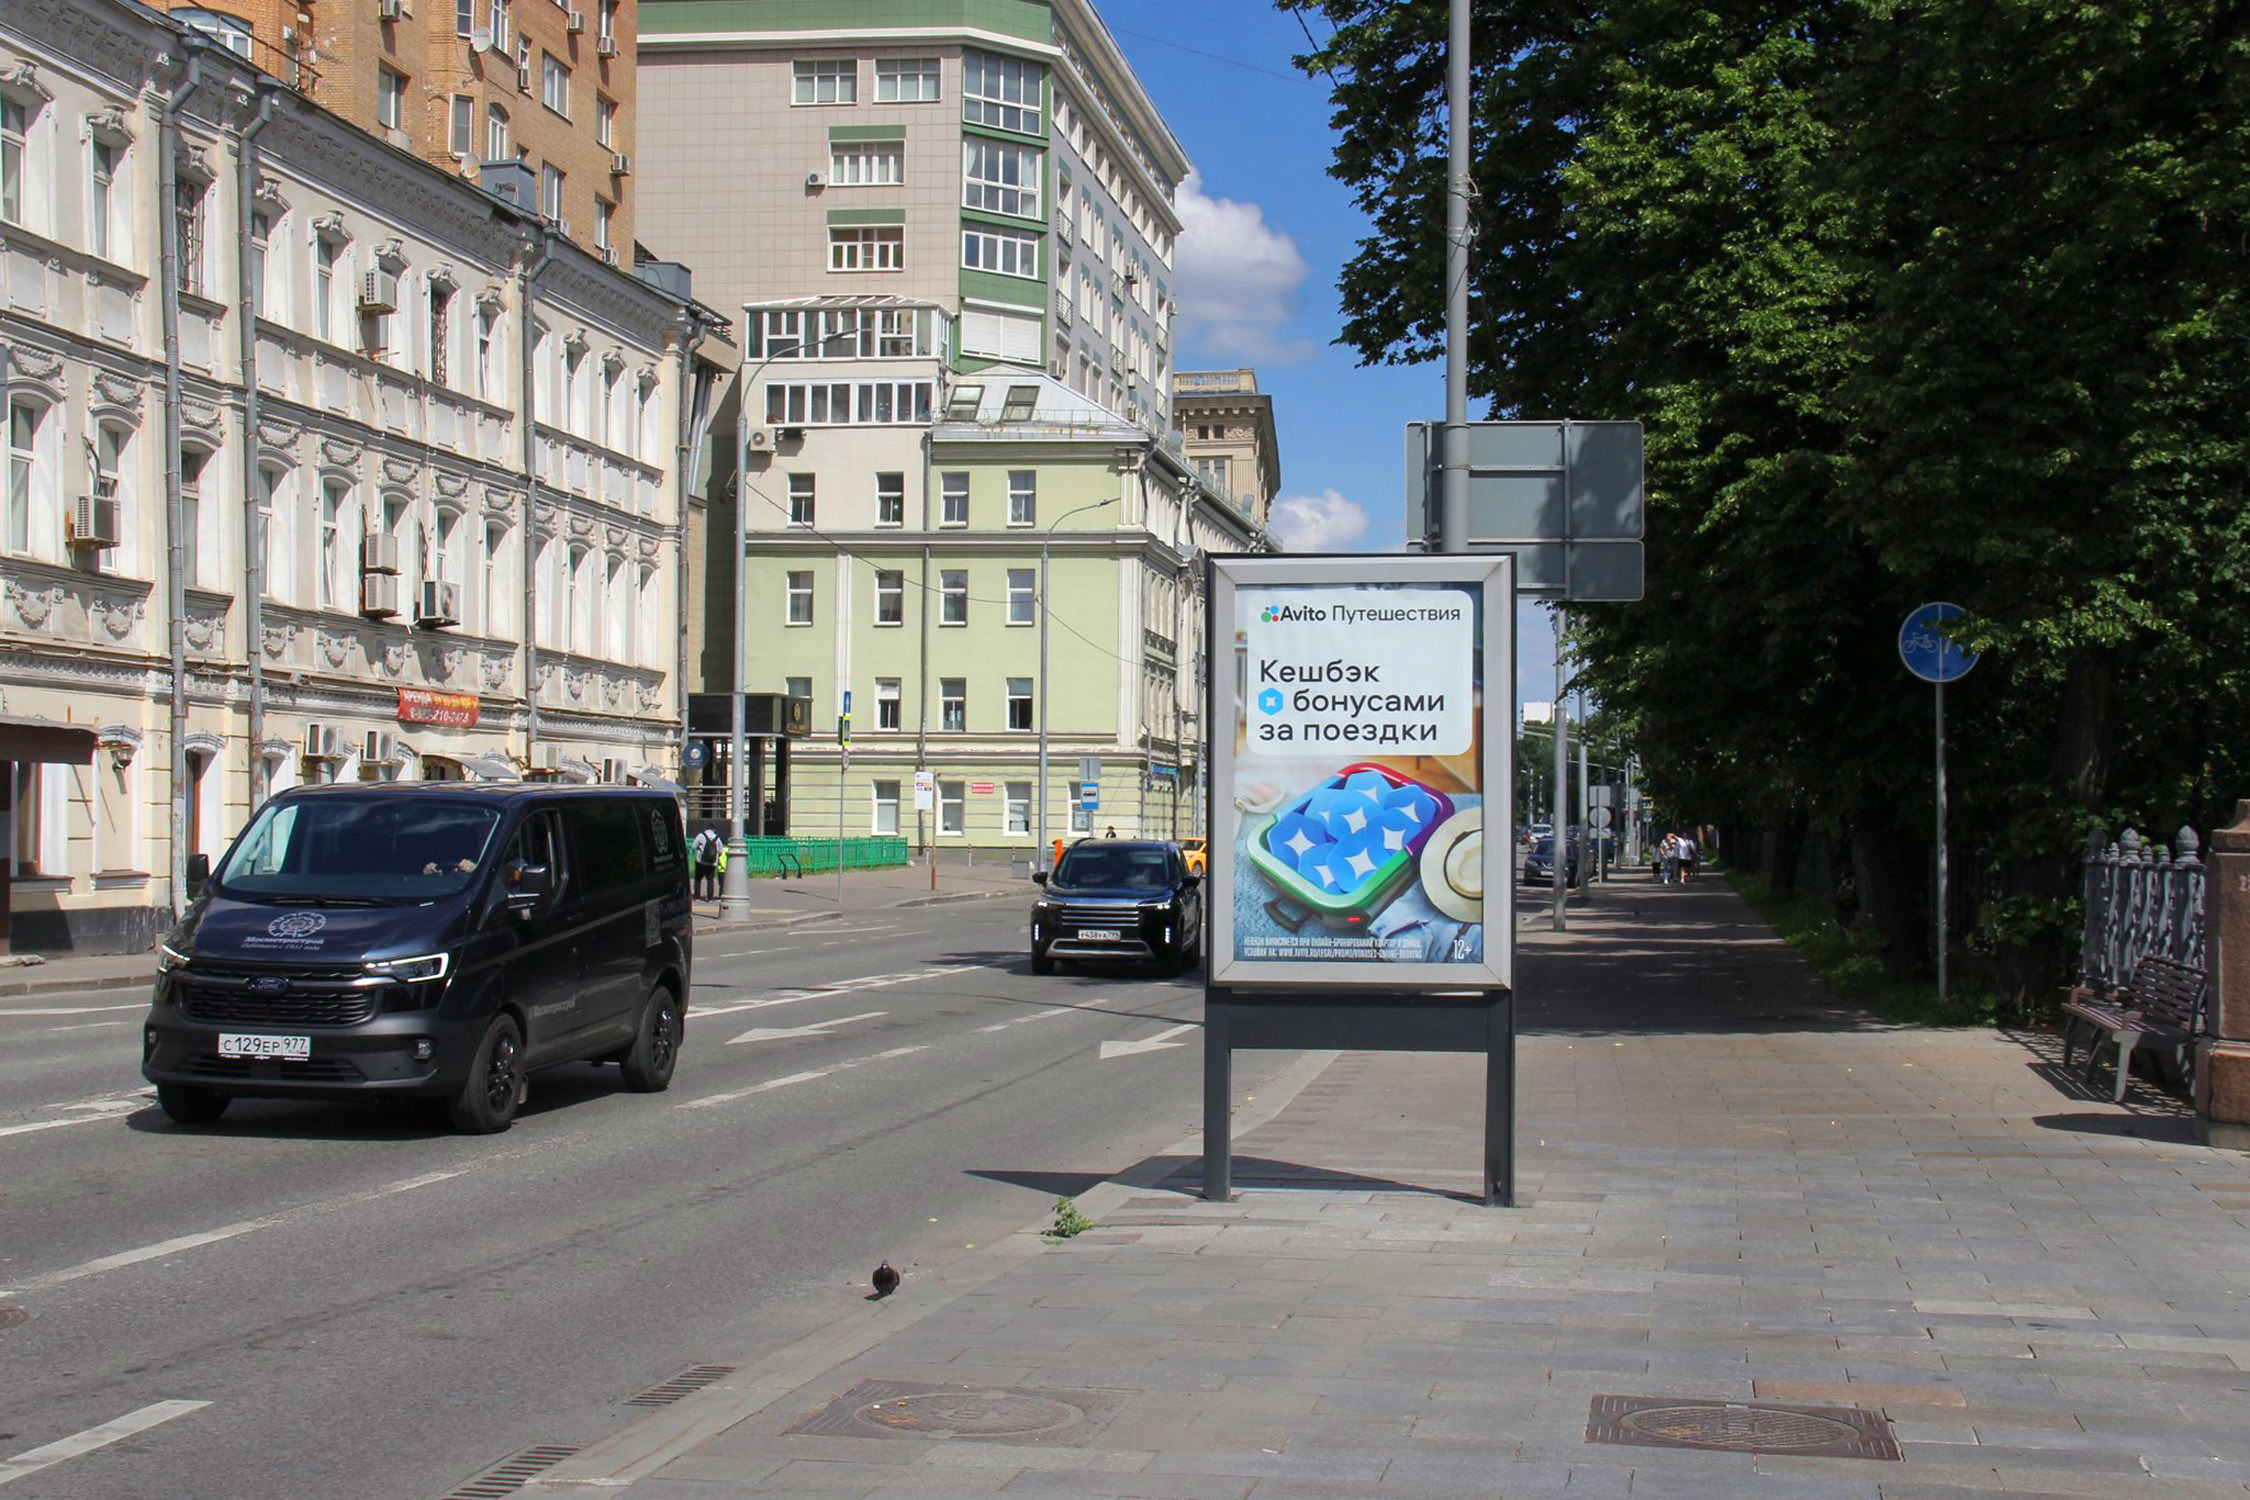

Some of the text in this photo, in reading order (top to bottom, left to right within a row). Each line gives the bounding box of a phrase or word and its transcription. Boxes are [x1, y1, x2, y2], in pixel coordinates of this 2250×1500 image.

[1280, 605, 1460, 625] Avito Путешествия
[1260, 659, 1380, 682] Кешбэк
[1293, 688, 1444, 718] бонусами
[1258, 724, 1437, 744] за поездки
[1453, 939, 1473, 960] 12+
[223, 1036, 307, 1053] С129ЕР 977
